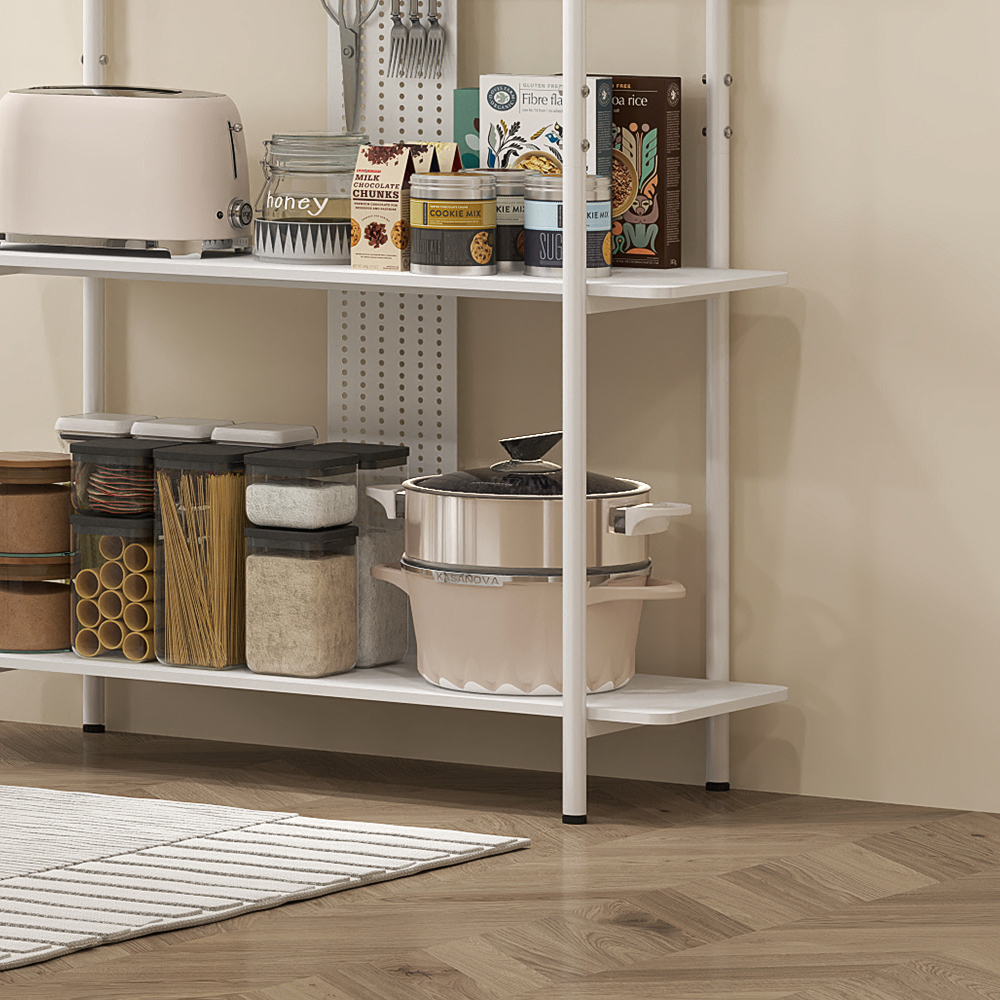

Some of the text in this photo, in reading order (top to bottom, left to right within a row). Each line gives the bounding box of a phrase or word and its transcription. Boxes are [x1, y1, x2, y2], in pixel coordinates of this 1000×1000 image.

[522, 93, 563, 106] Fibre fla
[628, 94, 648, 107] rice
[353, 181, 400, 189] CHOCOLATE
[352, 189, 399, 199] CHUNKS
[266, 190, 329, 216] honey
[430, 209, 463, 217] COOKIE
[496, 205, 510, 213] KIE
[586, 211, 598, 219] KIE
[539, 232, 563, 261] SUG
[436, 572, 500, 585] KASANOVA
